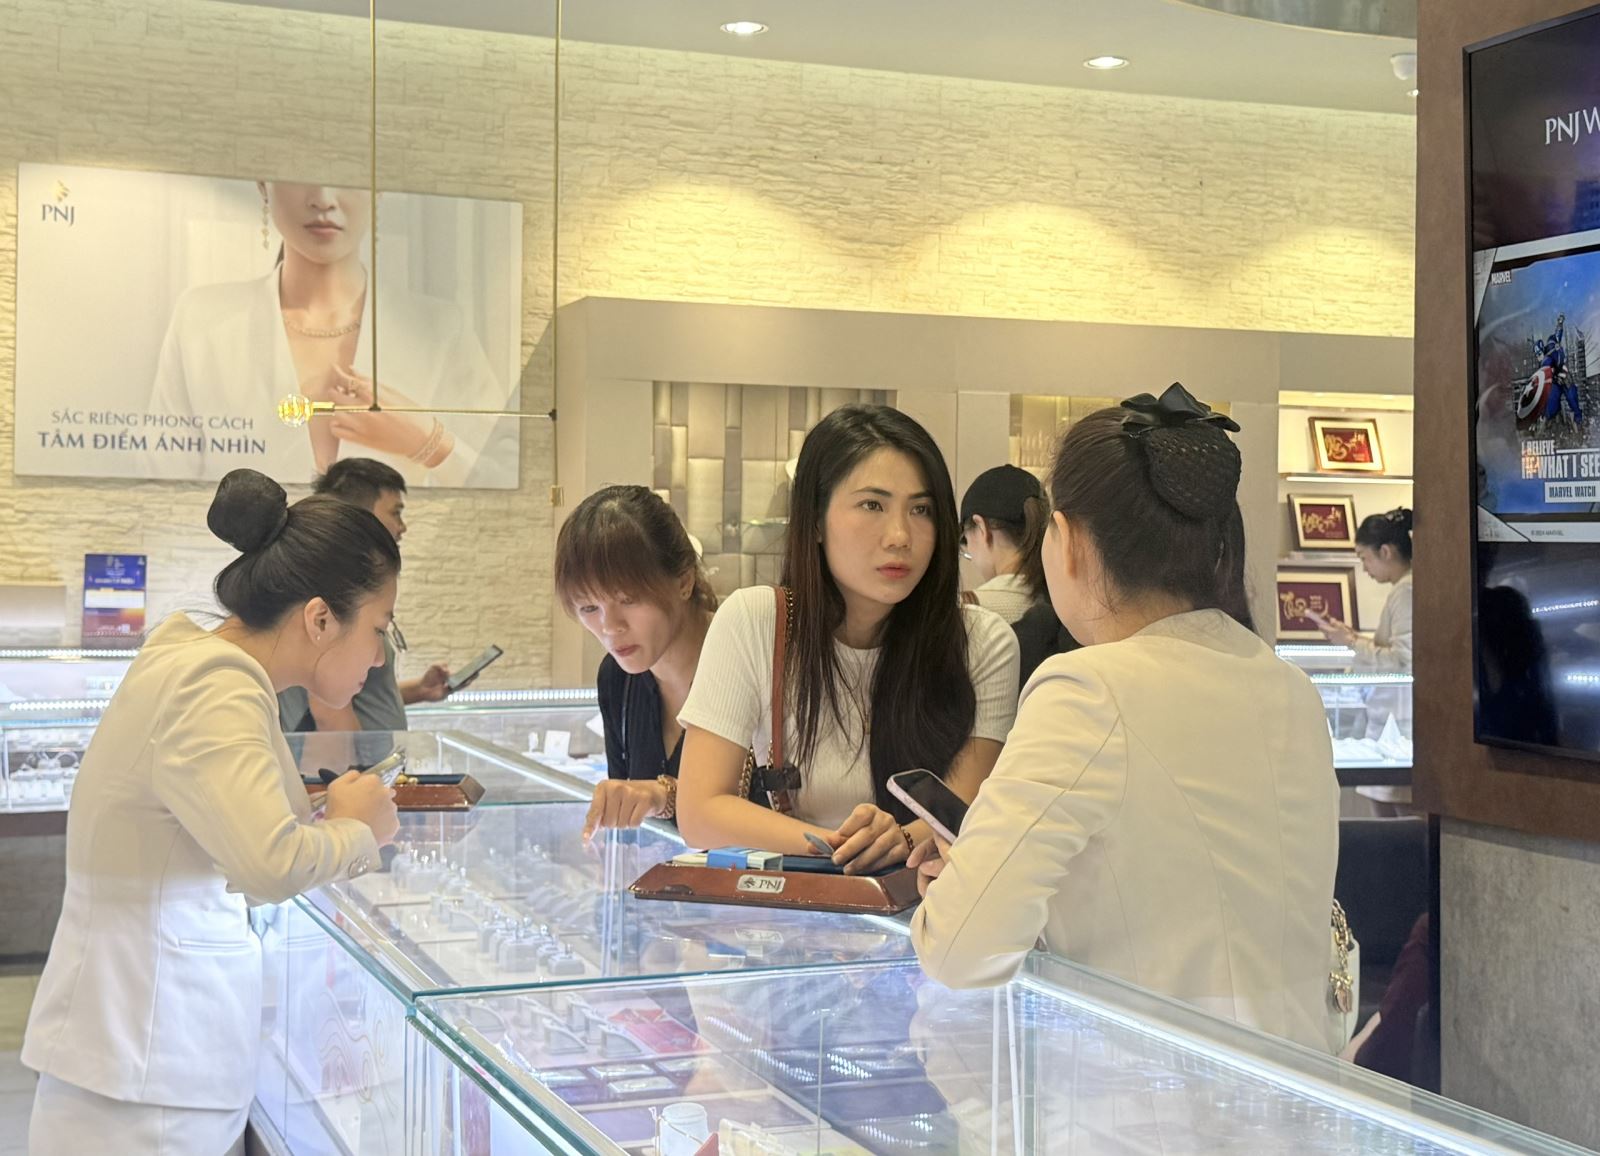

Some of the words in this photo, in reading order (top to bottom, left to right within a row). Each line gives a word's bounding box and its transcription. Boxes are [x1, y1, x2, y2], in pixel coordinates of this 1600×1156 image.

[42, 204, 74, 227] PNJ
[144, 414, 203, 429] PHONG
[155, 432, 201, 452] ÁNH
[1527, 440, 1555, 455] BELIEVE
[1536, 454, 1569, 479] WHAT
[1572, 454, 1577, 478] I
[1549, 486, 1573, 498] MARVEL
[1575, 485, 1596, 498] WATCH
[759, 879, 782, 891] PNJ
